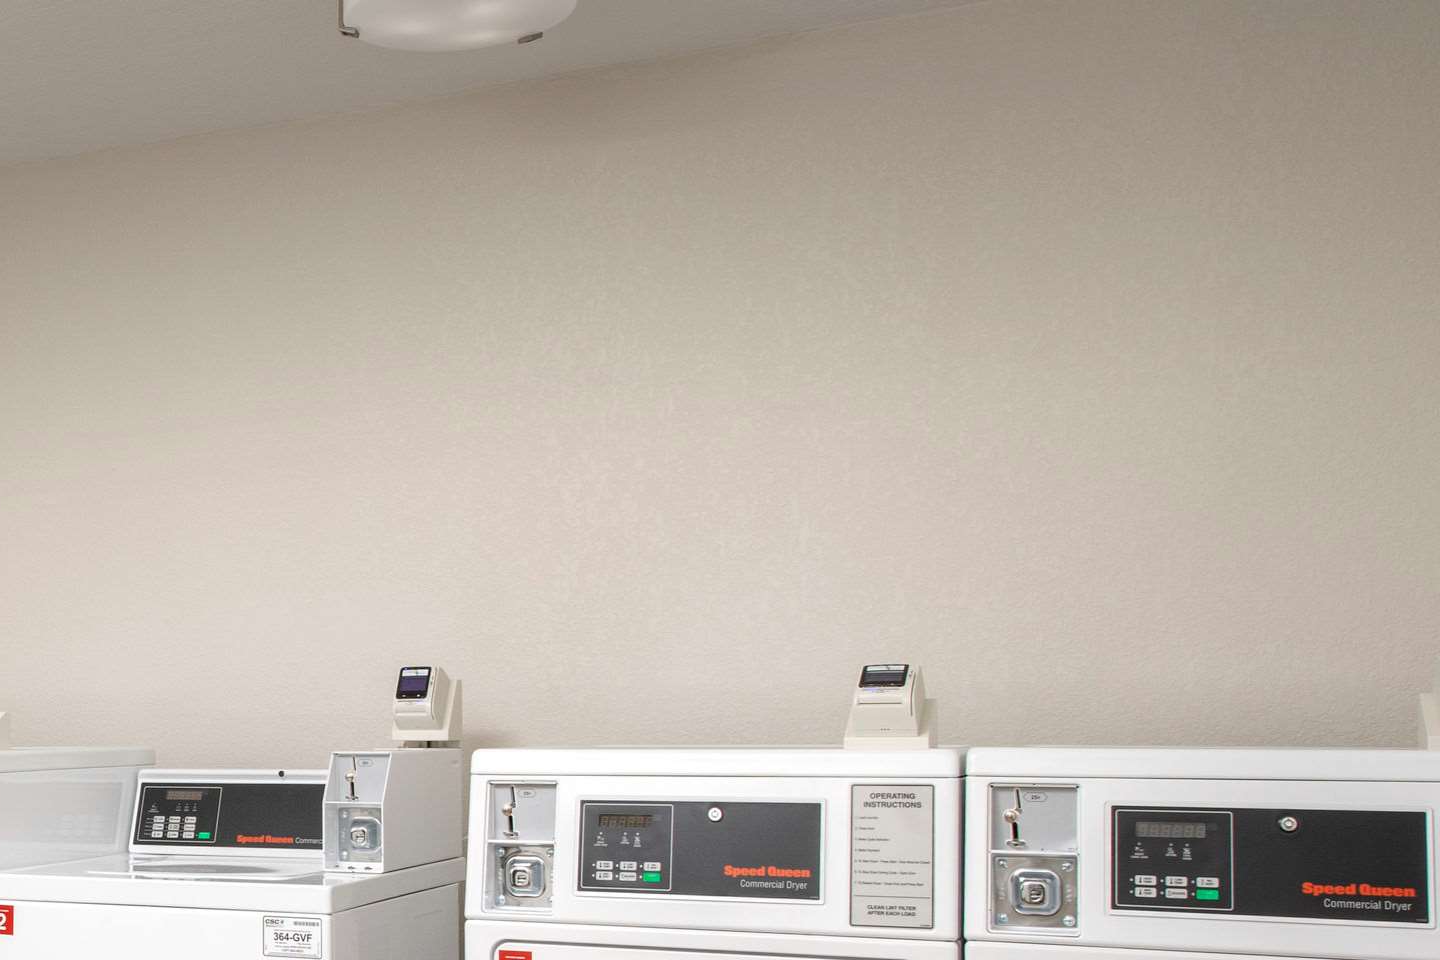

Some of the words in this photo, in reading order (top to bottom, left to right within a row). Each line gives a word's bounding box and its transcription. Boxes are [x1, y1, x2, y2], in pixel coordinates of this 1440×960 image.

[723, 864, 766, 878] Speed
[767, 865, 811, 878] Queen
[740, 879, 785, 889] Commercial
[786, 880, 808, 891] Dryer
[1301, 881, 1357, 896] Speed
[1359, 883, 1416, 897] Queen
[1323, 898, 1382, 910] Commercial
[1384, 900, 1412, 913] Dryer
[273, 932, 313, 942] 364-GVF
